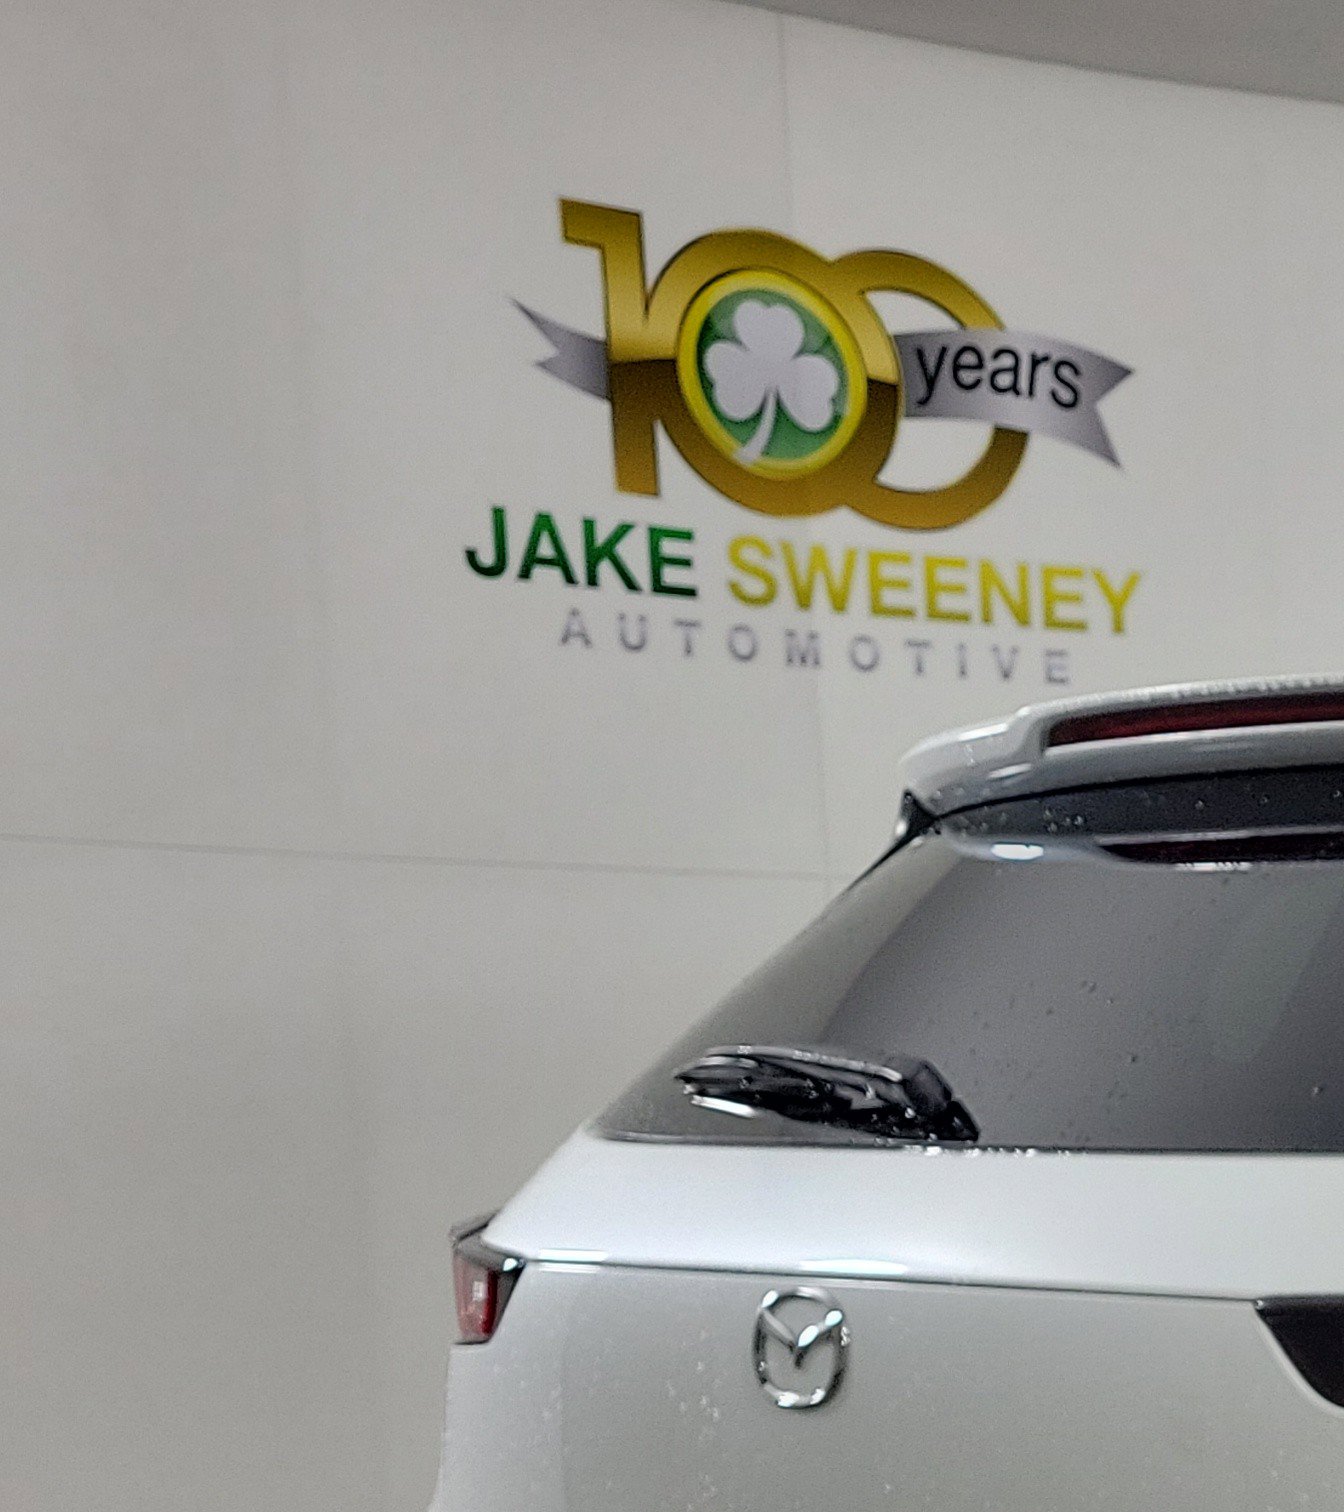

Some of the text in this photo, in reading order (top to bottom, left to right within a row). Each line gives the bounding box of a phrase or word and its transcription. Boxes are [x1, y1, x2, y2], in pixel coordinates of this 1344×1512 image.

[557, 195, 1083, 534] 100 years
[463, 504, 1144, 637] JAKE SWEENEY
[559, 607, 1072, 688] AUTOMOTIVE
